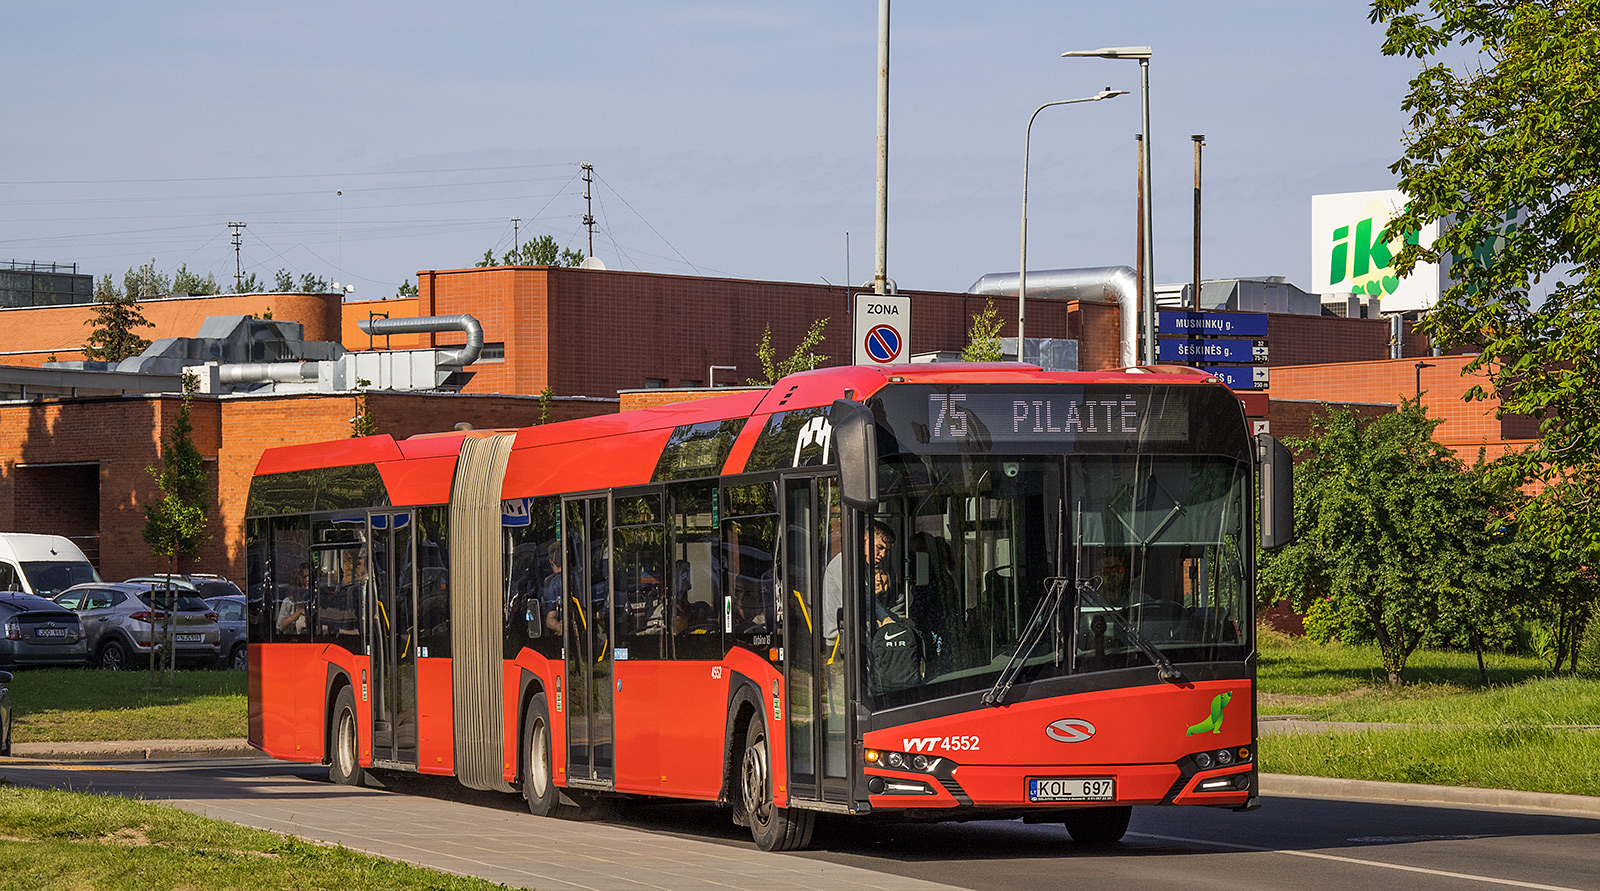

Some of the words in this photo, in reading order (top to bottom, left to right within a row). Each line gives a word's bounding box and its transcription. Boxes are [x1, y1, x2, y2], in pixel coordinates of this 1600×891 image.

[867, 304, 899, 315] ZONA
[1175, 319, 1223, 331] MUSNINKŲ
[1225, 321, 1234, 331] g.
[1178, 343, 1222, 355] ŠEŠKINĖS
[1224, 347, 1233, 357] g.
[1226, 374, 1236, 384] g.
[930, 393, 968, 437] 75
[1013, 394, 1137, 433] PILAITĖ
[885, 640, 906, 648] AIR
[711, 665, 722, 680] 4552
[940, 735, 980, 751] 4552
[1039, 781, 1072, 796] KOL
[1083, 781, 1110, 796] 697
